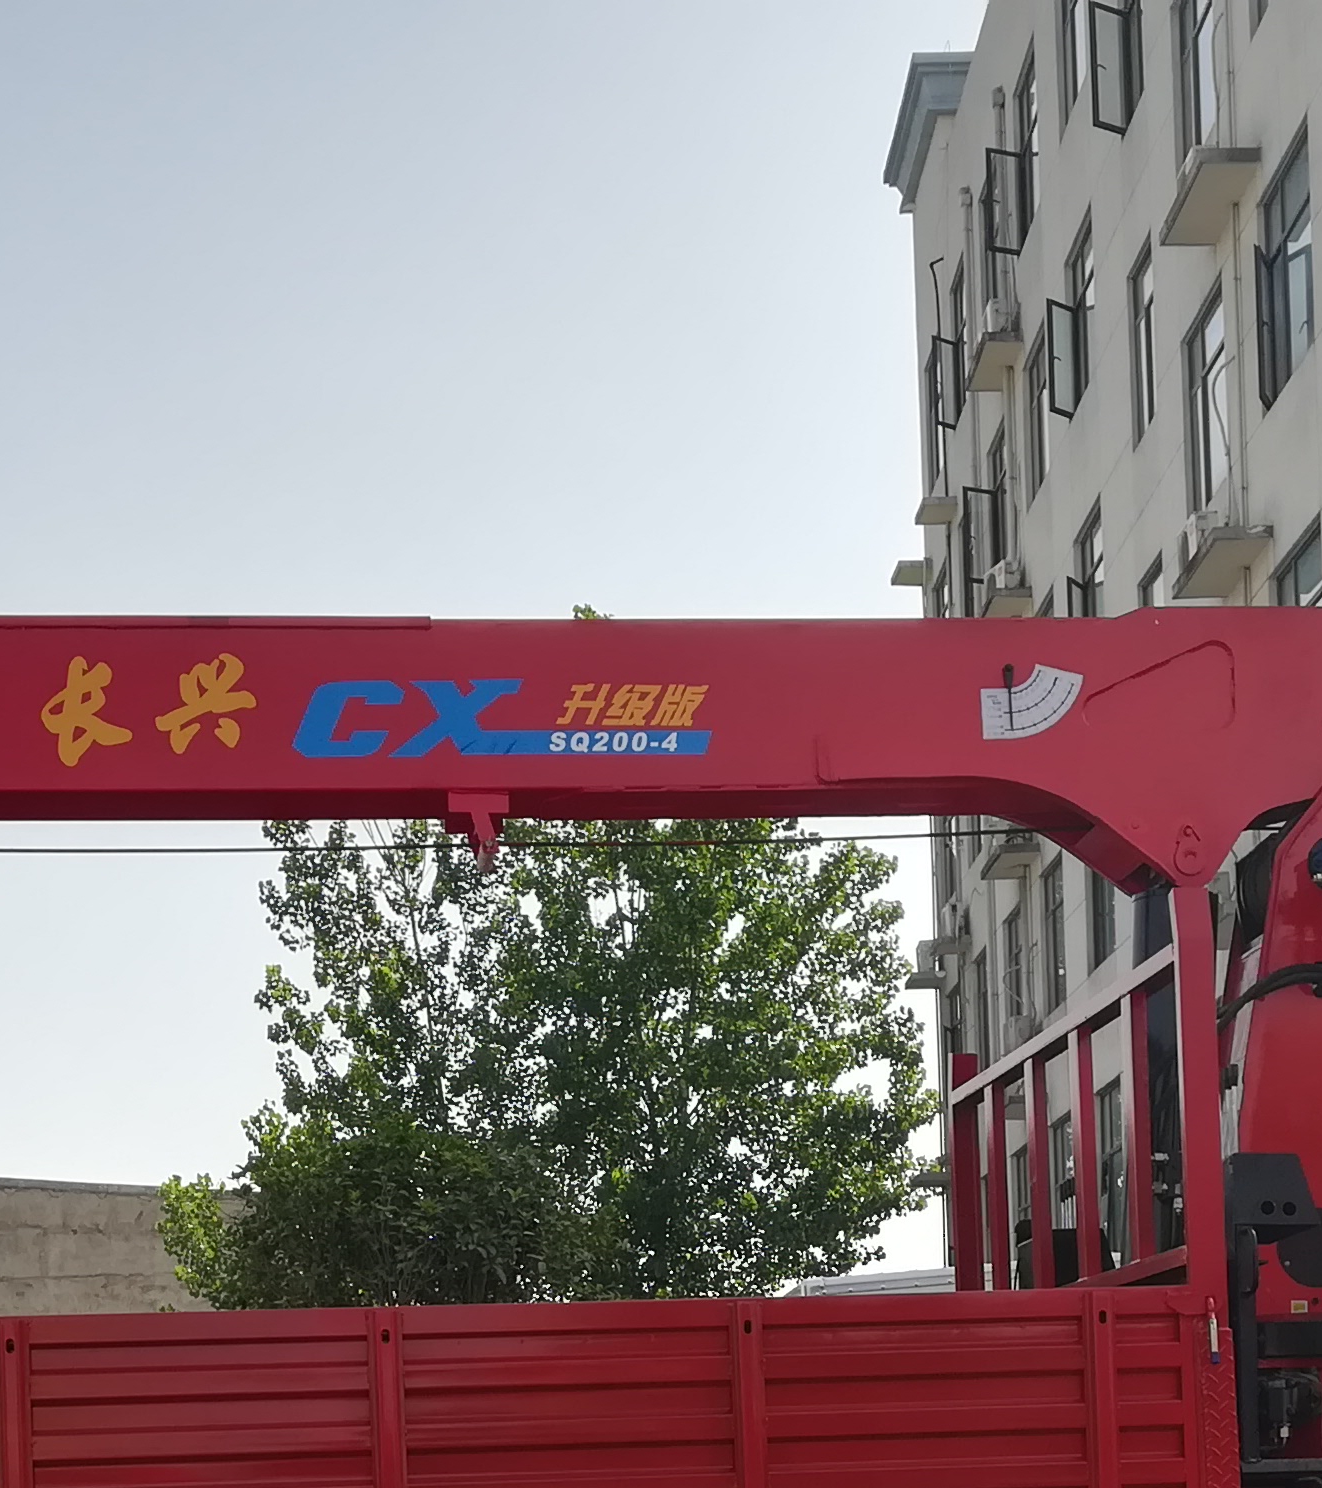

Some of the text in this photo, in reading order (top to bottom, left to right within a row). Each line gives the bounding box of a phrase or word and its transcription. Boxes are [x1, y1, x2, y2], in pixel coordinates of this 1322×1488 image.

[40, 652, 256, 767] 长兴
[292, 678, 523, 758] CX
[556, 683, 709, 729] 升级版
[549, 731, 679, 754] SQ200-4
